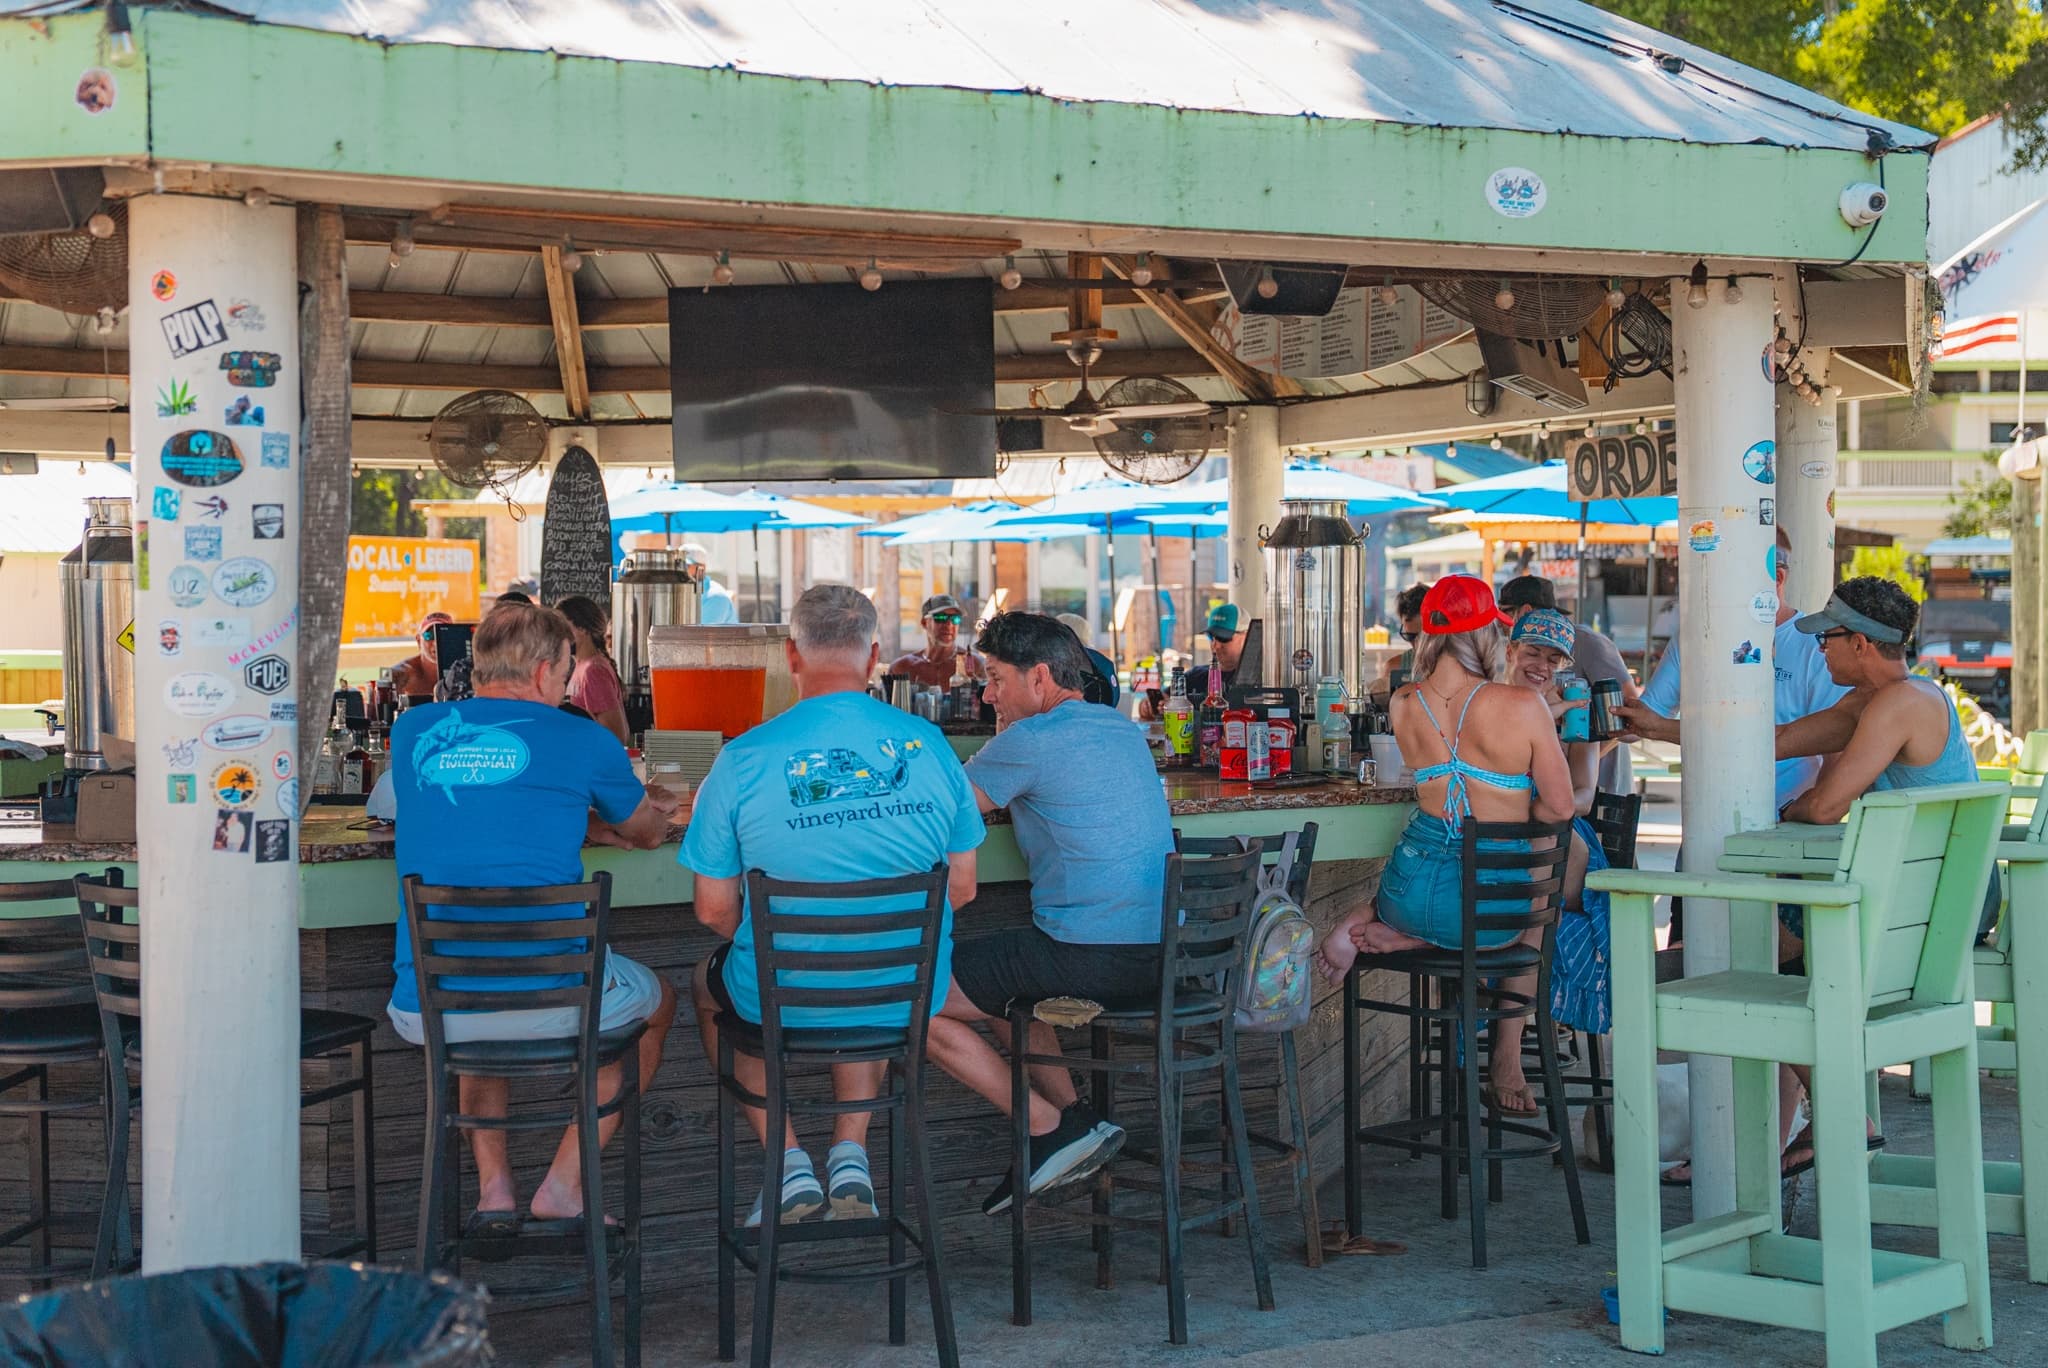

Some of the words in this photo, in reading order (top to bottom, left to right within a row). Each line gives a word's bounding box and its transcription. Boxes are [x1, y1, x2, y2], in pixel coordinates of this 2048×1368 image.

[161, 301, 222, 351] PULP
[347, 544, 402, 571] OCAL
[251, 661, 288, 689] FUEL
[439, 753, 517, 769] FISHERMAN
[786, 802, 883, 831] vineyard
[885, 799, 935, 817] vines
